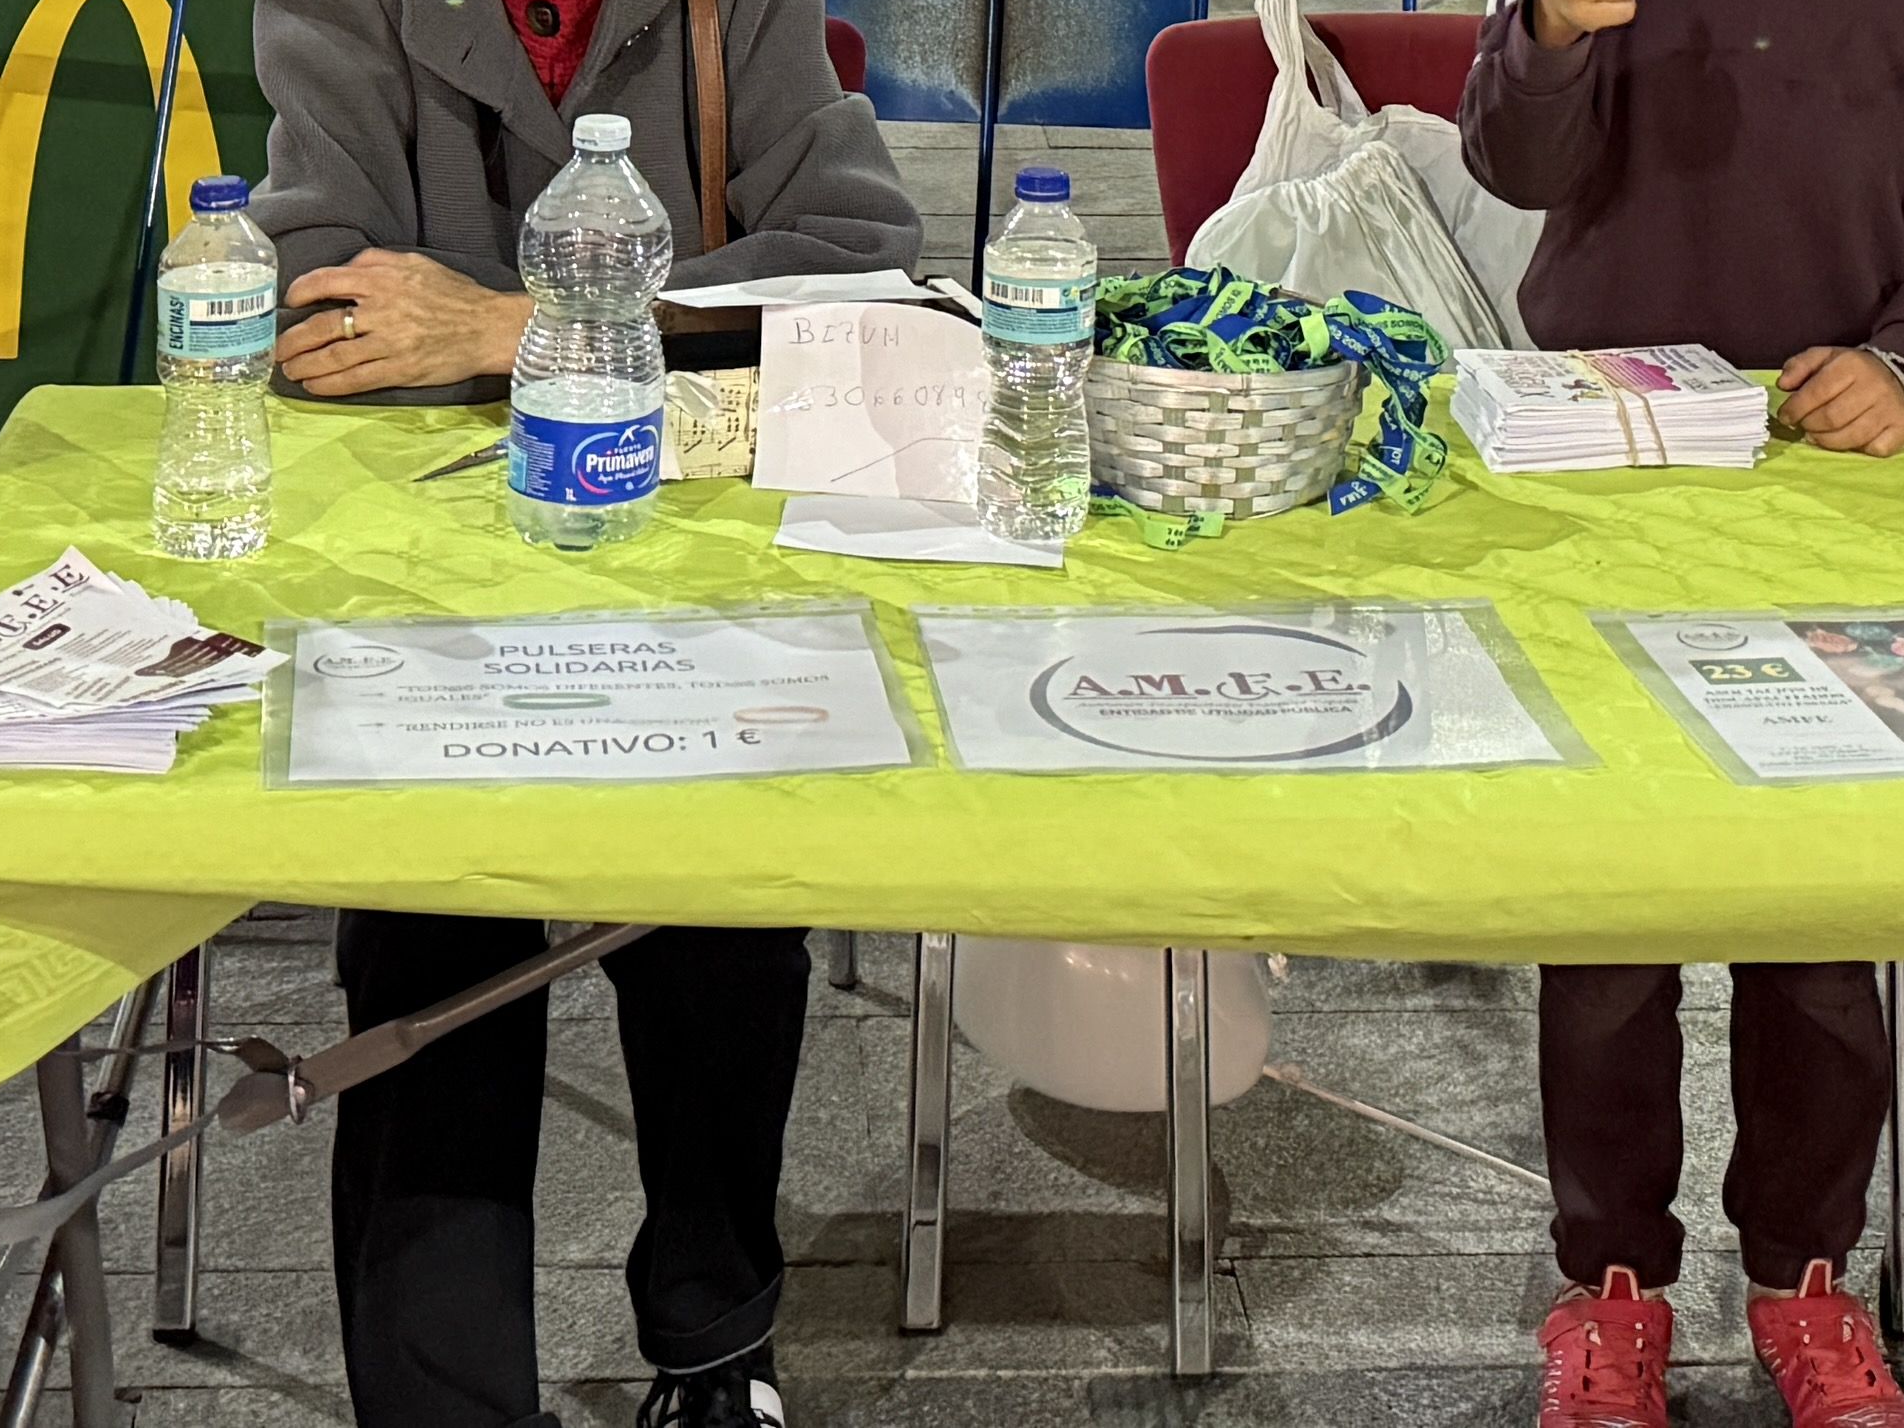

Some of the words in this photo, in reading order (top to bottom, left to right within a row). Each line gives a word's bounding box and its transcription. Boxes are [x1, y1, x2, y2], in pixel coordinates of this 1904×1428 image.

[169, 300, 185, 350] ENCINAS
[499, 641, 677, 657] PULSERAS
[484, 659, 696, 675] SOLIDARIAS
[1702, 664, 1753, 680] 23
[1761, 663, 1790, 678] €
[515, 718, 546, 728] NO
[443, 732, 687, 759] DONATIVO:
[702, 730, 718, 749] 1
[736, 728, 762, 746] €
